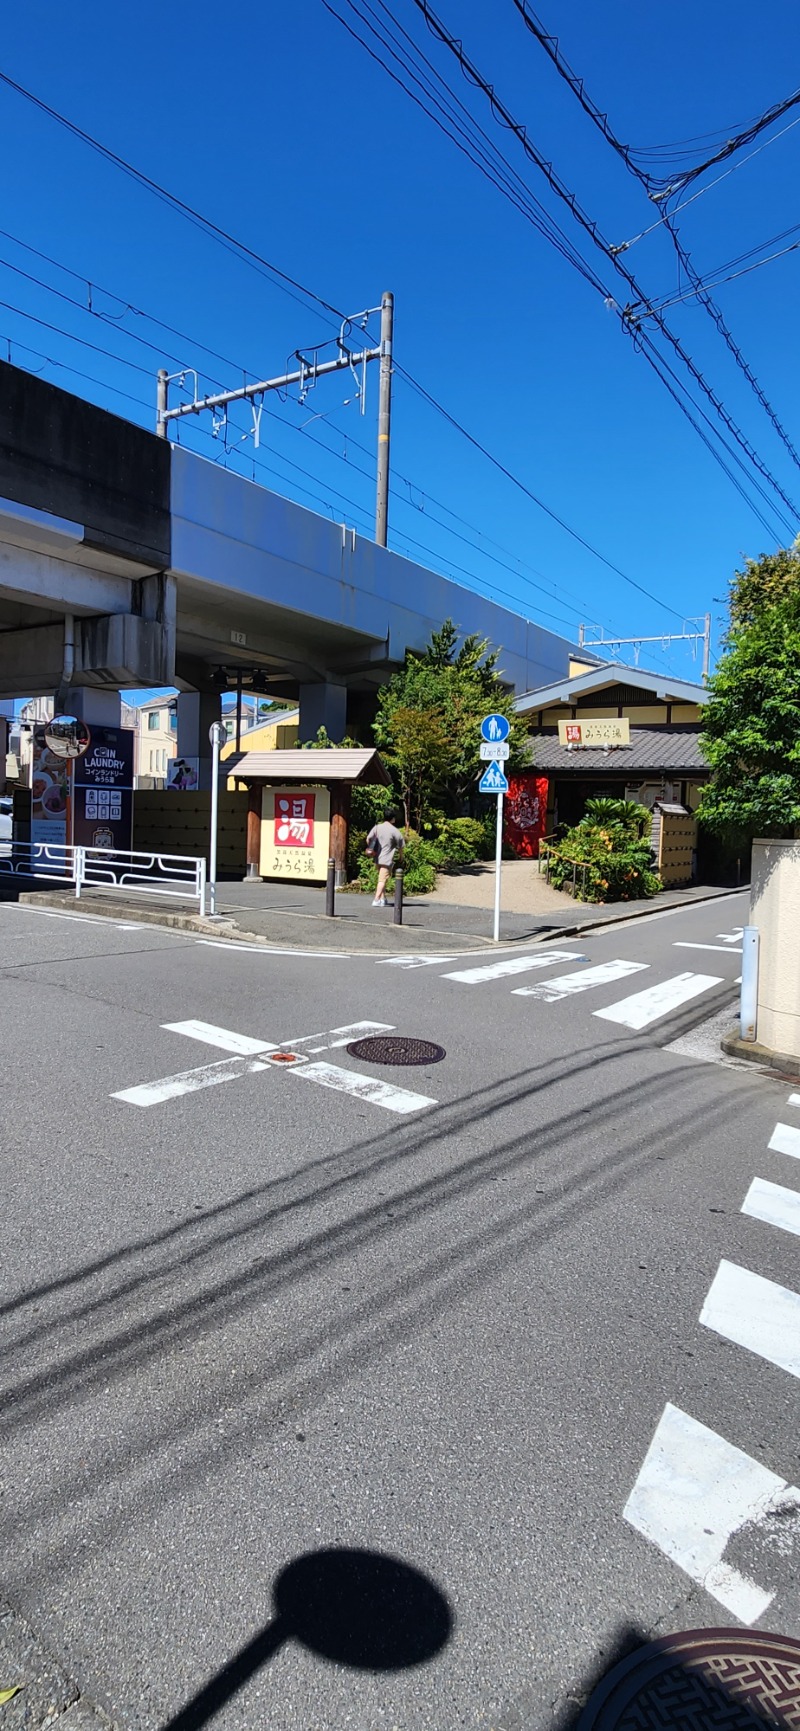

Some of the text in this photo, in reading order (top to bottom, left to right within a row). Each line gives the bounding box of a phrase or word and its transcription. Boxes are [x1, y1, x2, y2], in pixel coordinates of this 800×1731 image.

[234, 633, 243, 643] 12
[567, 727, 580, 740] 湯
[585, 728, 622, 739] みうら湯
[84, 758, 125, 770] LAUNDRY
[85, 769, 124, 777] コインランドリー
[94, 775, 115, 783] みうら湯
[277, 799, 310, 844] 湯
[273, 857, 315, 874] みうら湯
